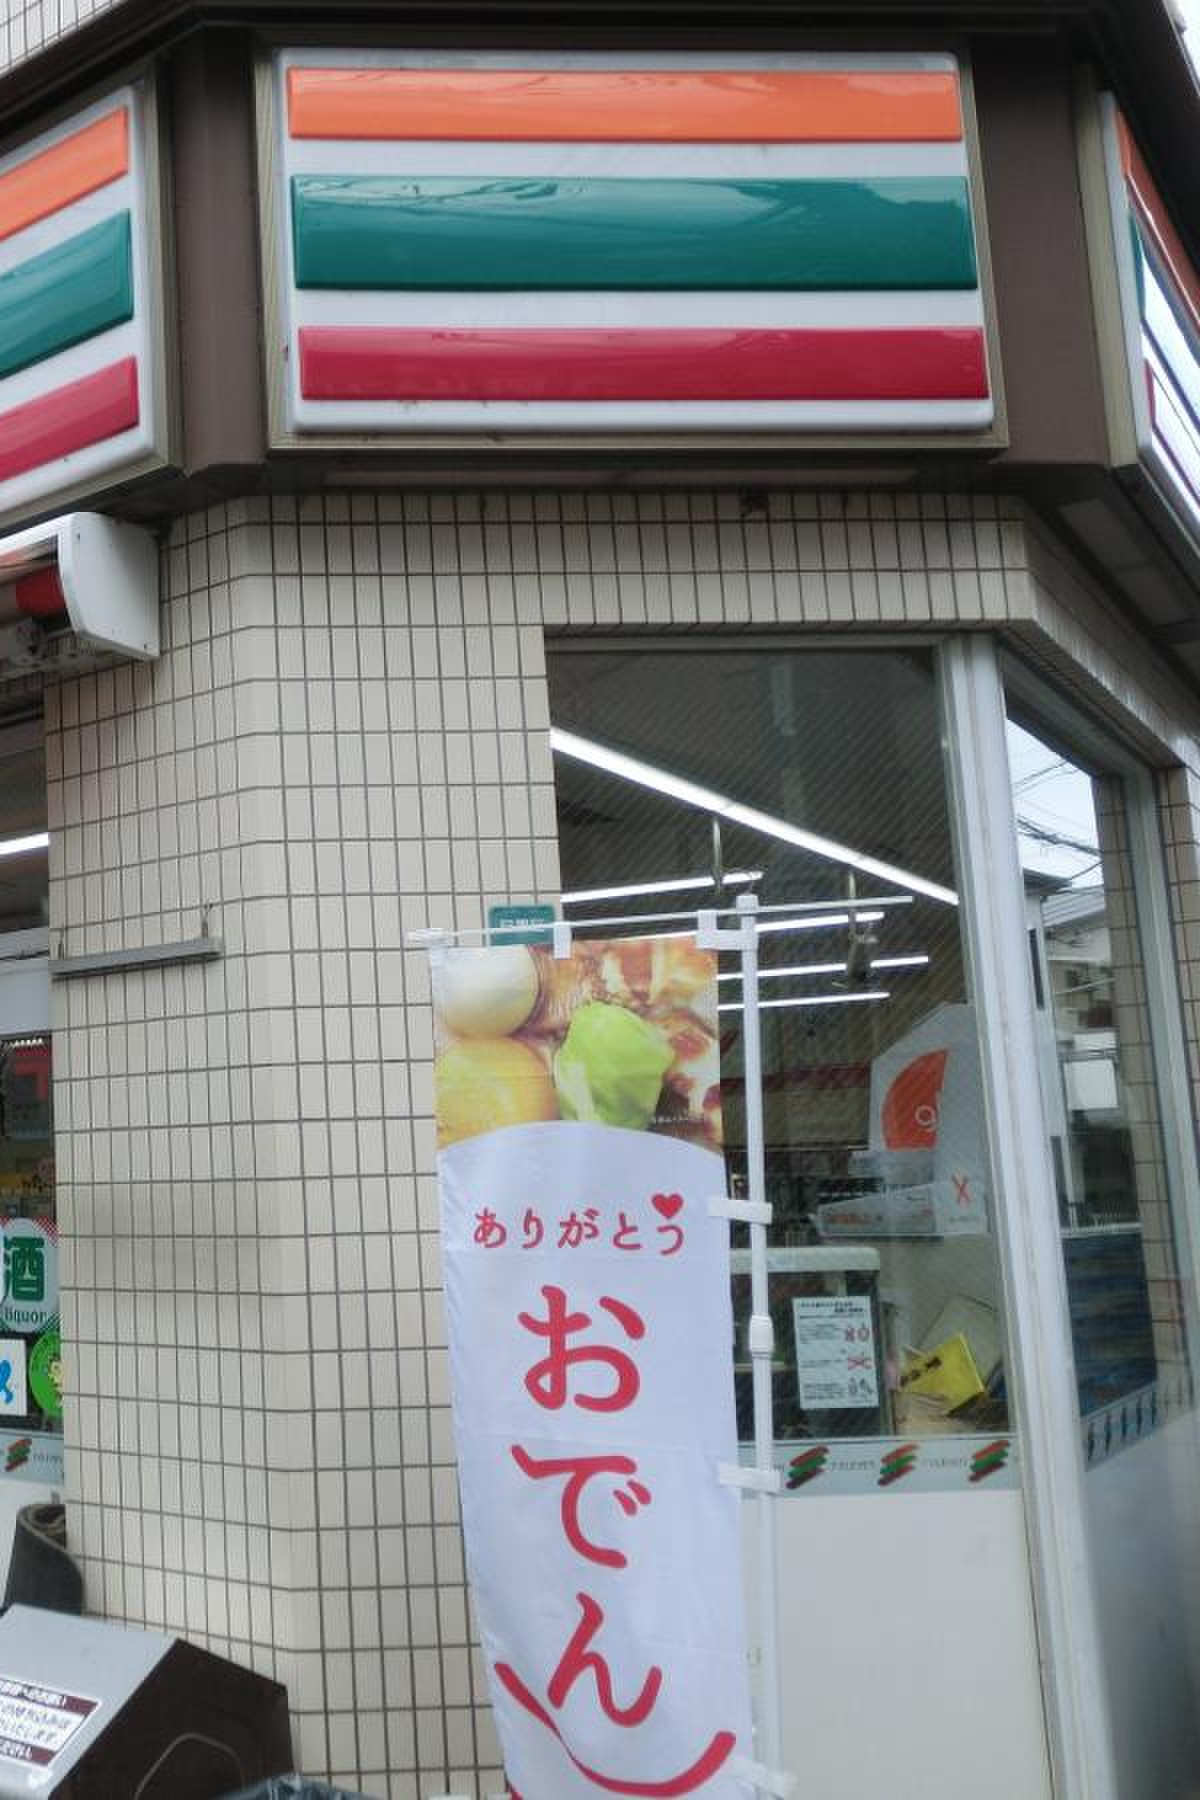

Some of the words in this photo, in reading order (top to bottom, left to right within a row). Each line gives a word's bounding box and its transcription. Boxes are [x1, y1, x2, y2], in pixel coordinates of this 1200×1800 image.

[473, 1207, 686, 1257] ありがとう
[3, 1235, 45, 1302] 酒
[4, 1306, 48, 1326] liquor
[511, 1285, 663, 1728] おでん
